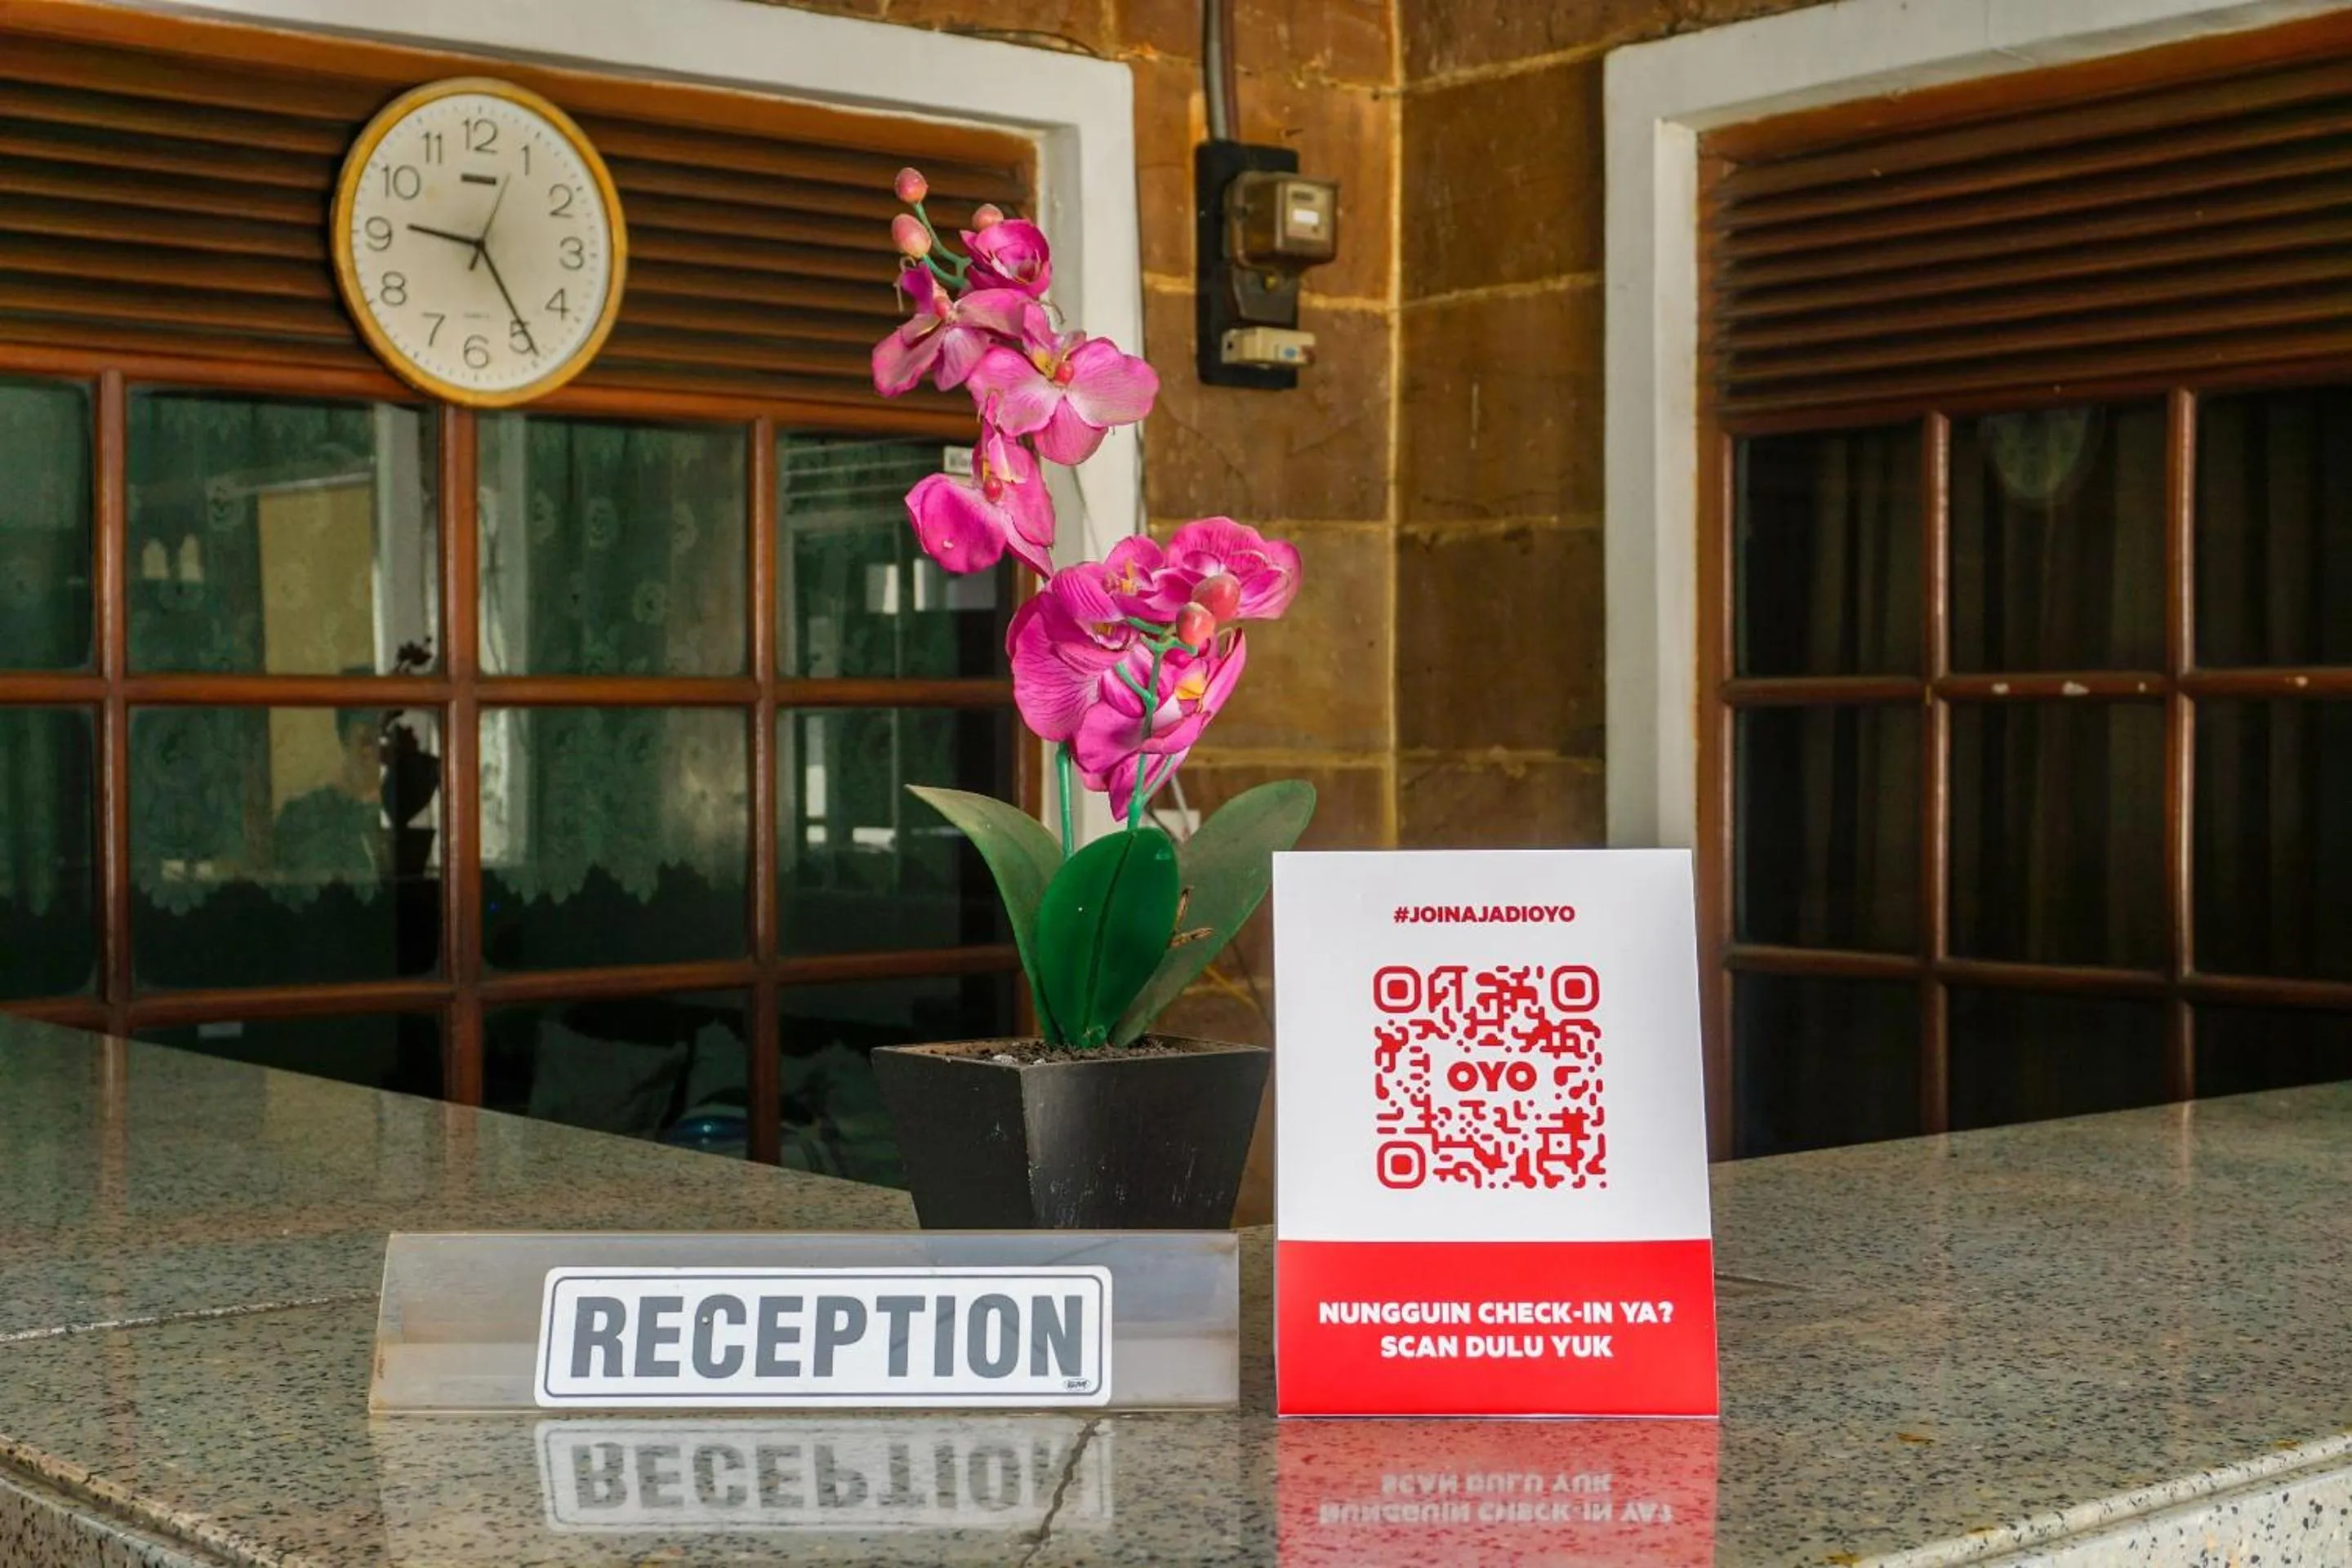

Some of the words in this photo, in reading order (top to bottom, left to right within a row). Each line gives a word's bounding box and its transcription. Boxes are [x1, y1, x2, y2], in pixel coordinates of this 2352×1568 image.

[421, 131, 443, 164] 11
[463, 118, 498, 154] 12
[520, 145, 531, 176] 1
[381, 164, 421, 201] 10
[549, 184, 574, 218] 2
[364, 216, 394, 252] 9
[559, 237, 586, 271] 3
[380, 271, 408, 306] 8
[545, 288, 571, 321] 4
[421, 312, 446, 347] 7
[509, 319, 534, 354] 5
[462, 335, 490, 369] 6
[1394, 905, 1576, 924] #JOINAJADIOYO
[1446, 1060, 1539, 1093] OYO
[1319, 1302, 1471, 1324] NUNGGUIN
[1477, 1302, 1613, 1325] CHECK-IN
[1619, 1301, 1674, 1323] YA?
[569, 1293, 1083, 1379] RECEPTION
[1380, 1335, 1459, 1358] SCAN
[1465, 1335, 1544, 1358] DULU
[1551, 1335, 1614, 1358] YUK
